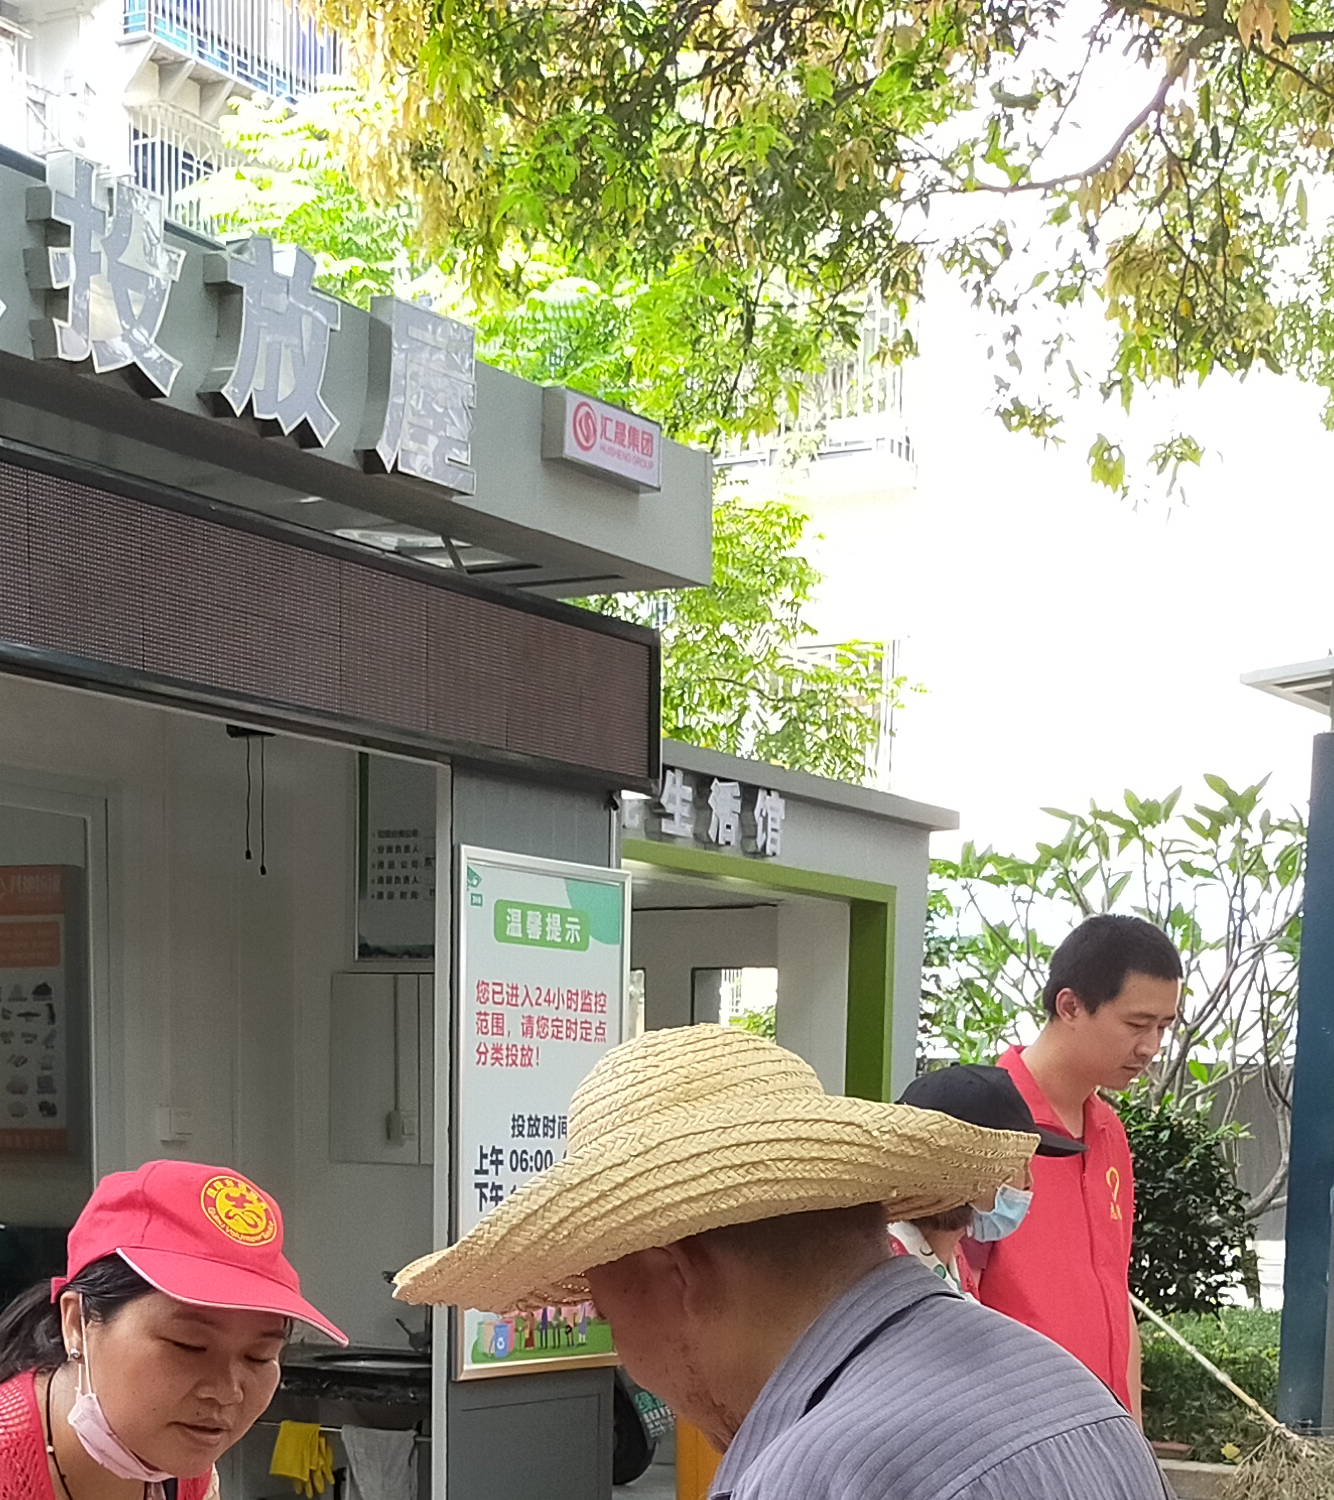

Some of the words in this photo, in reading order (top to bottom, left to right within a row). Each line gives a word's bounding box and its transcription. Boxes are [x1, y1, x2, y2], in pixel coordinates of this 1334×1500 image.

[623, 769, 786, 857] 生活馆
[505, 908, 582, 945] 温馨提示
[475, 979, 608, 1015] 您已进入24小时监控
[475, 1011, 607, 1043] 范围，请您定时定点
[474, 1145, 504, 1176] 上午
[509, 1149, 554, 1173] 06:00
[474, 1181, 504, 1212] 下午
